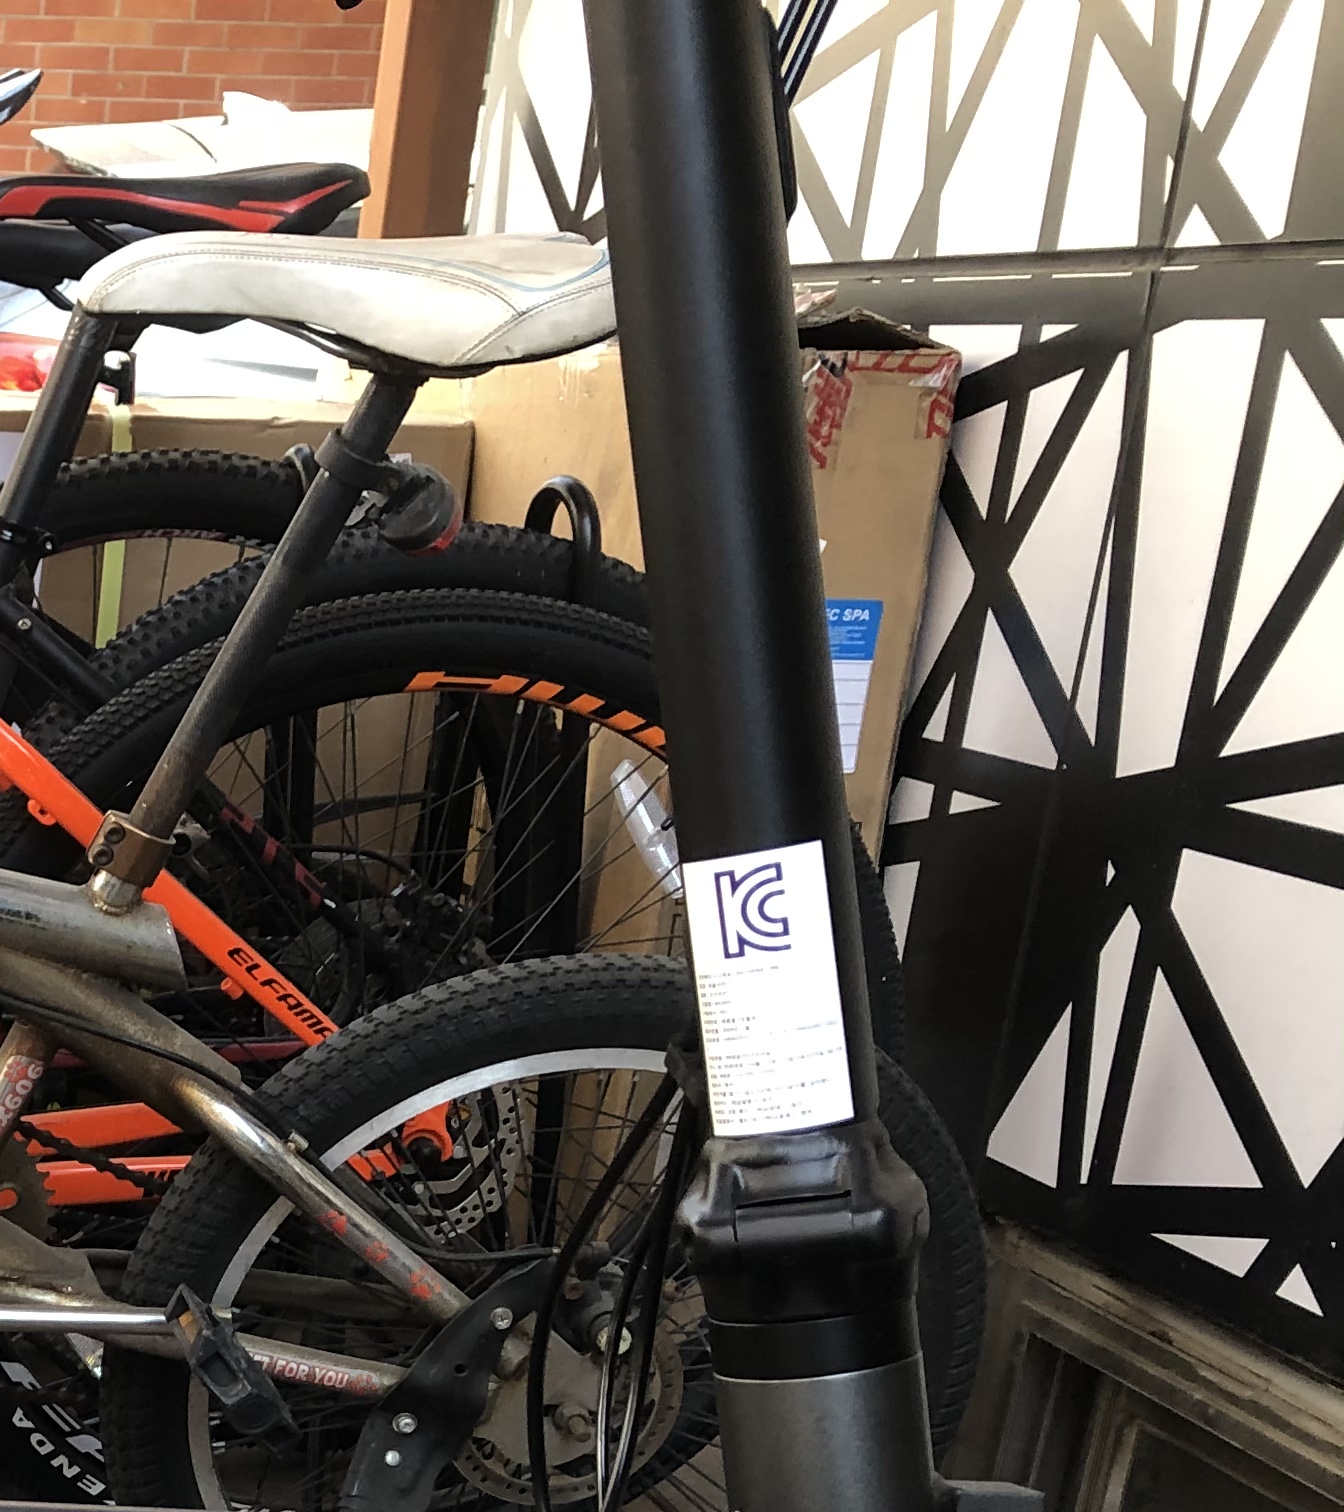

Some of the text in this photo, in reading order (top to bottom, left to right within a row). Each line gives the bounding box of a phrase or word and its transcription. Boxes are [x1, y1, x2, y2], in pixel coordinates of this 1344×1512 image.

[842, 608, 870, 622] SPA
[273, 1358, 311, 1382] FOR
[313, 1367, 350, 1389] YOU
[12, 1406, 116, 1506] ENDA
